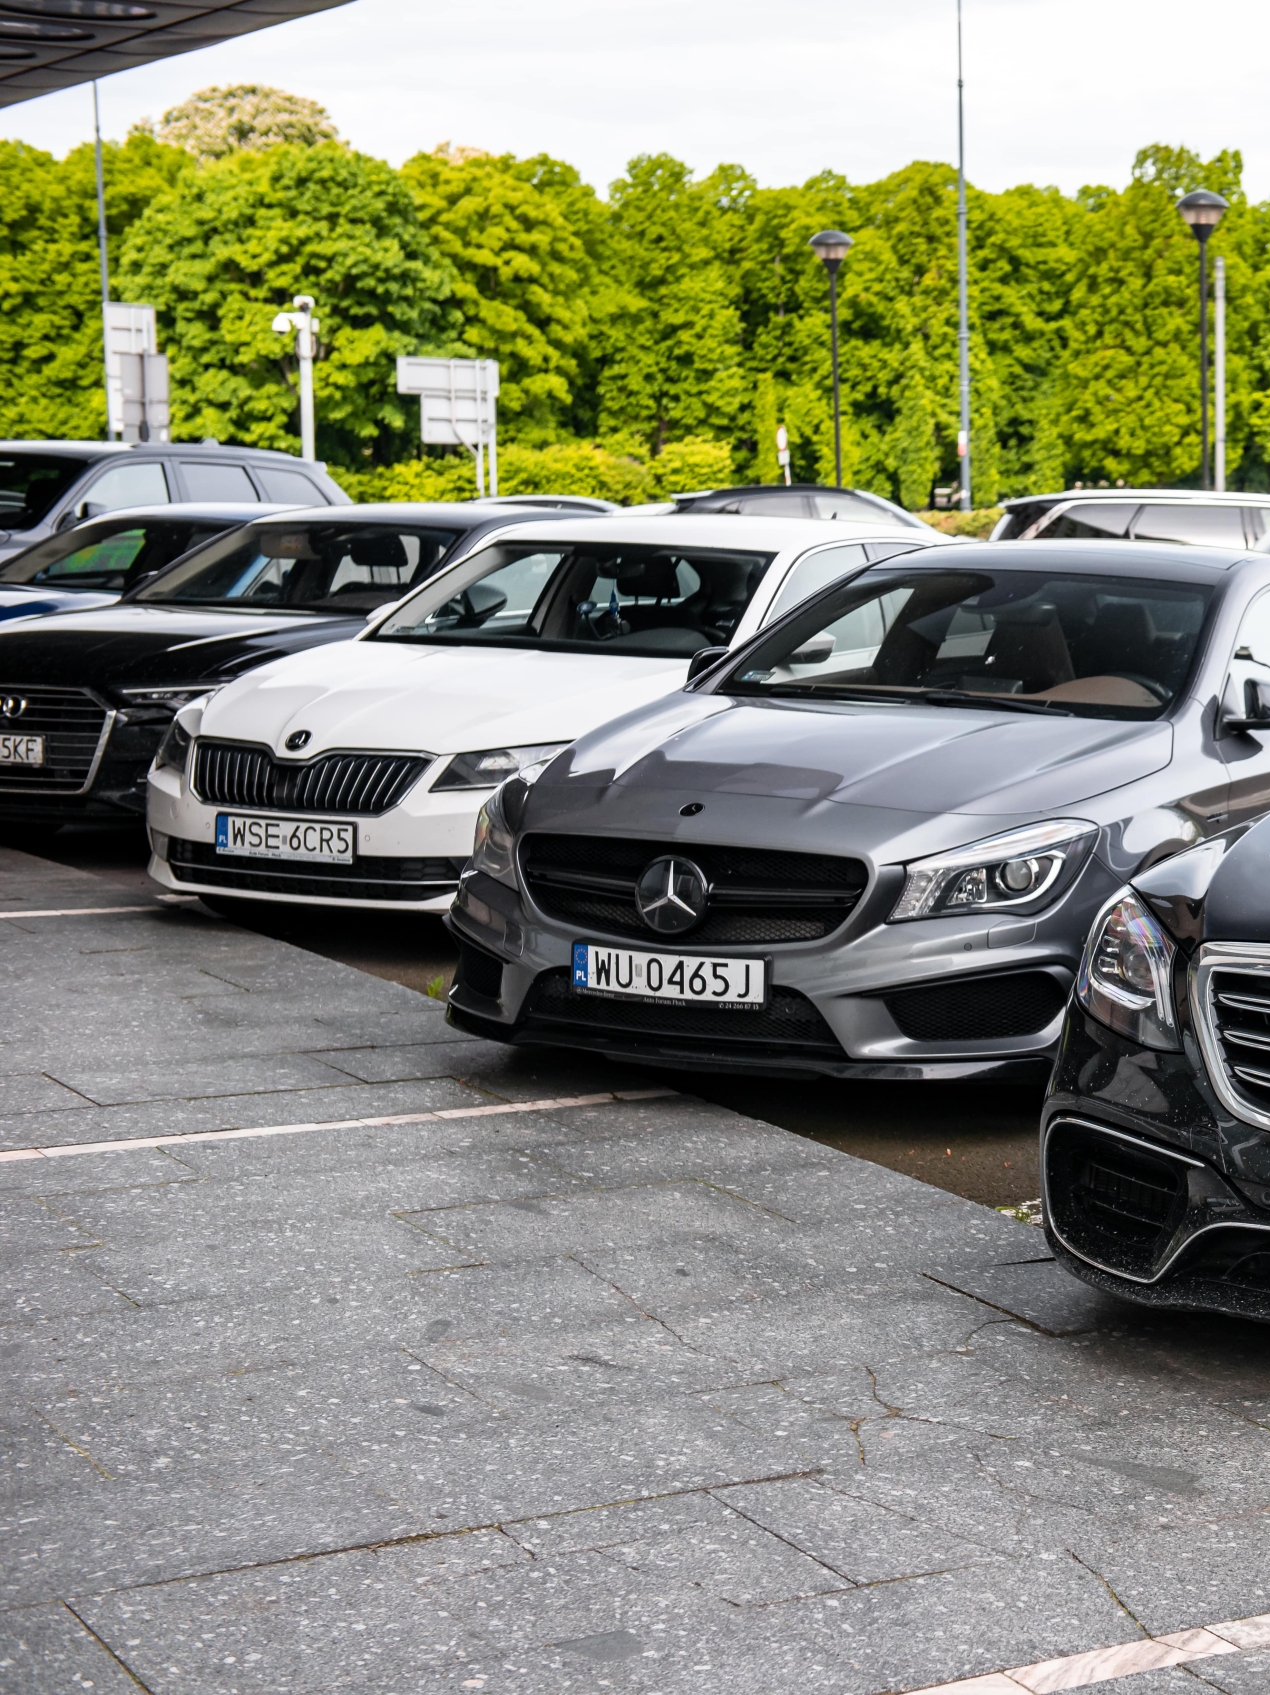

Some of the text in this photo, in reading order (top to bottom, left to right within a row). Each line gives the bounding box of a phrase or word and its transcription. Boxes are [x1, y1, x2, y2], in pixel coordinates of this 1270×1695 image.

[1, 737, 37, 761] 5KF
[219, 834, 227, 843] PL
[232, 819, 349, 854] WSE 6CR5
[576, 970, 586, 981] PL
[594, 951, 750, 999] WU 0465J
